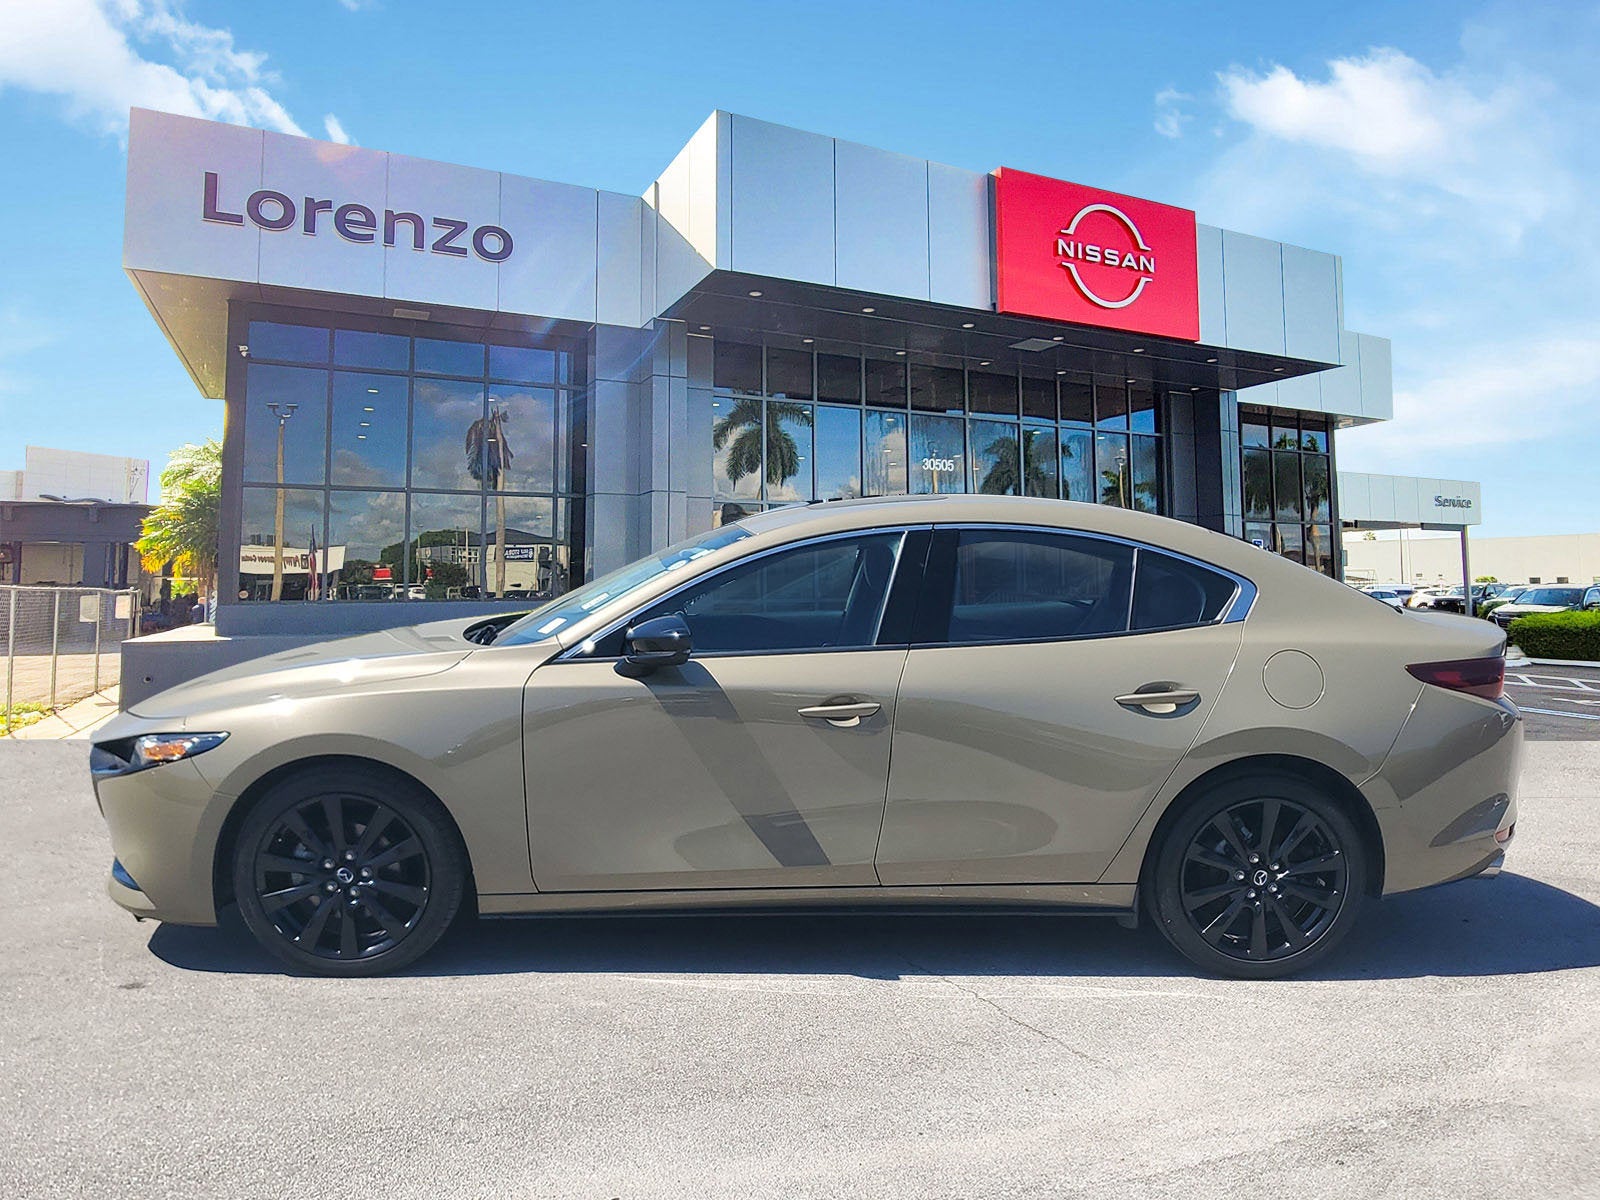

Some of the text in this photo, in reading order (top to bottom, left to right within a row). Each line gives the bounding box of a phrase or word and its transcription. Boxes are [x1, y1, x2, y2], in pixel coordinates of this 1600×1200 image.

[203, 171, 514, 263] Lorenzo
[1057, 238, 1155, 273] NISSAN
[922, 458, 955, 471] 30505
[1434, 495, 1472, 508] Service
